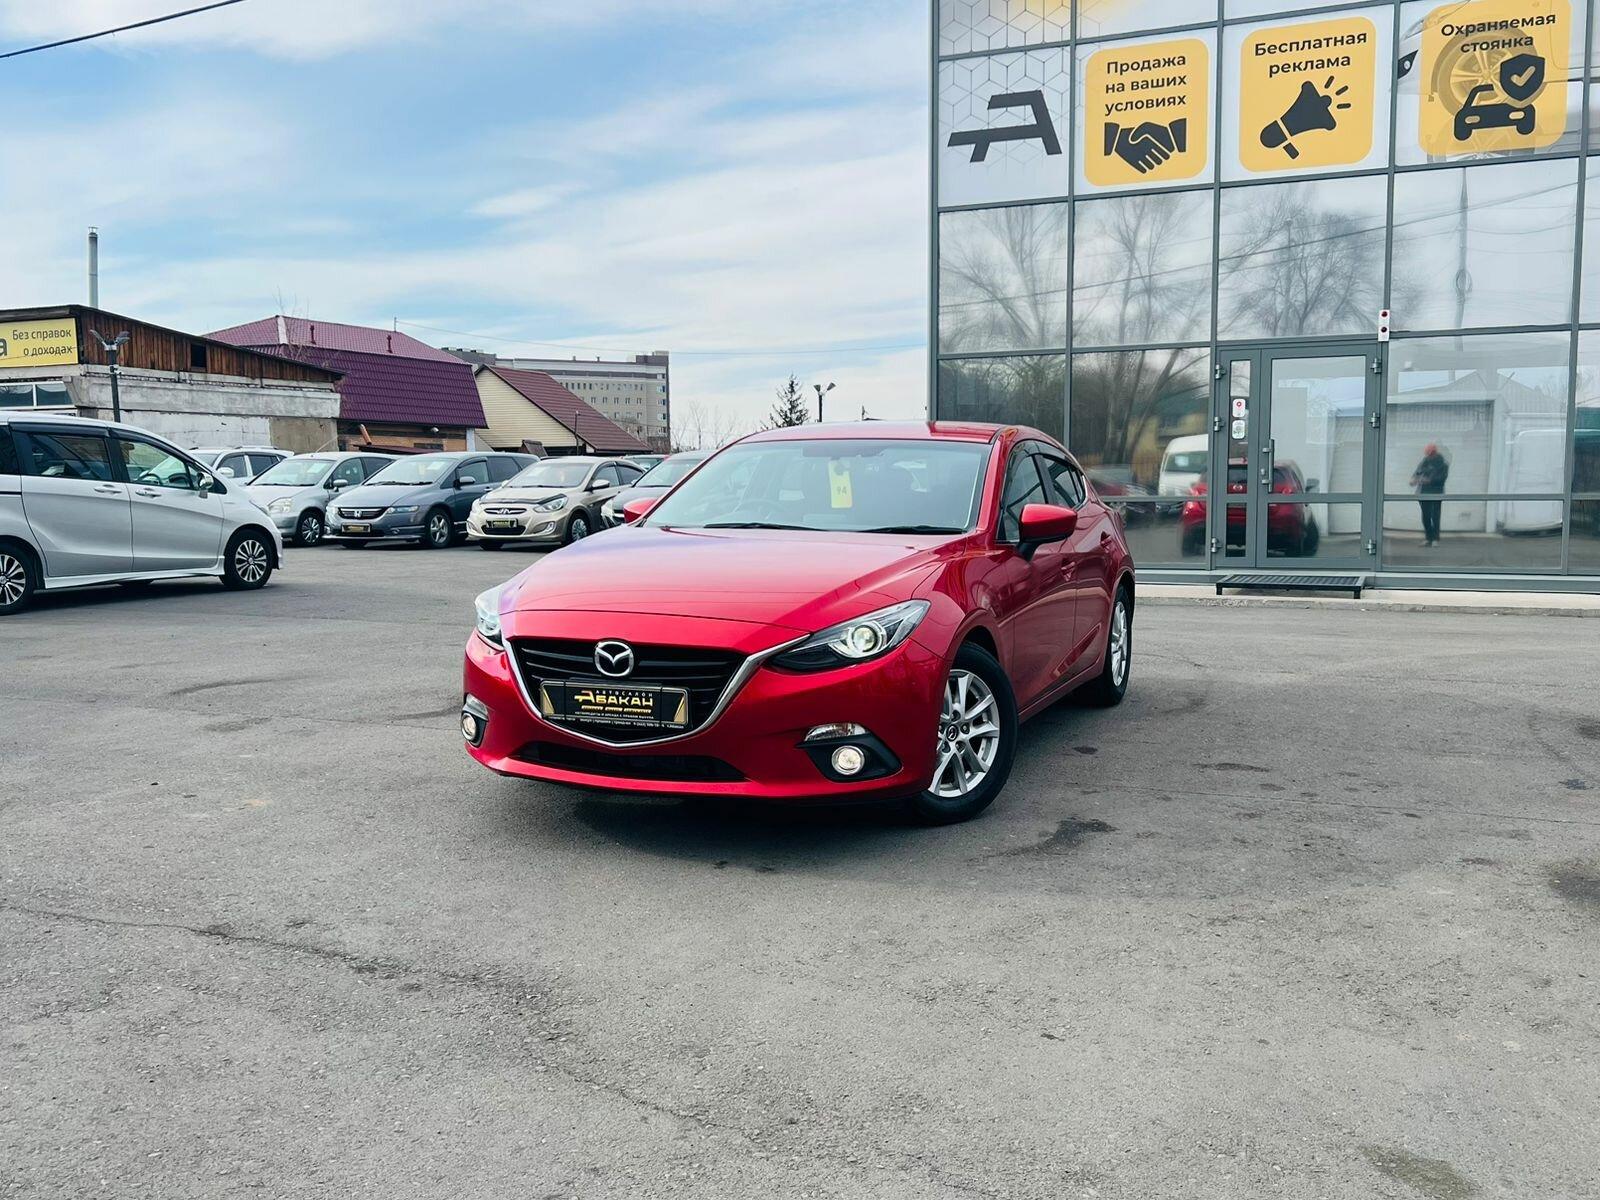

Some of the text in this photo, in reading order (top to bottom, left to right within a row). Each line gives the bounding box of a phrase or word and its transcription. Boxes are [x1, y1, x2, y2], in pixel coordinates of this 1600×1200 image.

[1440, 13, 1557, 37] Охраняемая
[1254, 31, 1368, 57] Бесплатная
[1460, 34, 1535, 54] стоянка
[1106, 54, 1187, 75] Продажа
[1268, 55, 1352, 78] реклама
[1105, 74, 1188, 94] на ваших
[1104, 94, 1187, 117] условиях
[12, 329, 72, 340] Без справок
[23, 346, 73, 356] о доходах
